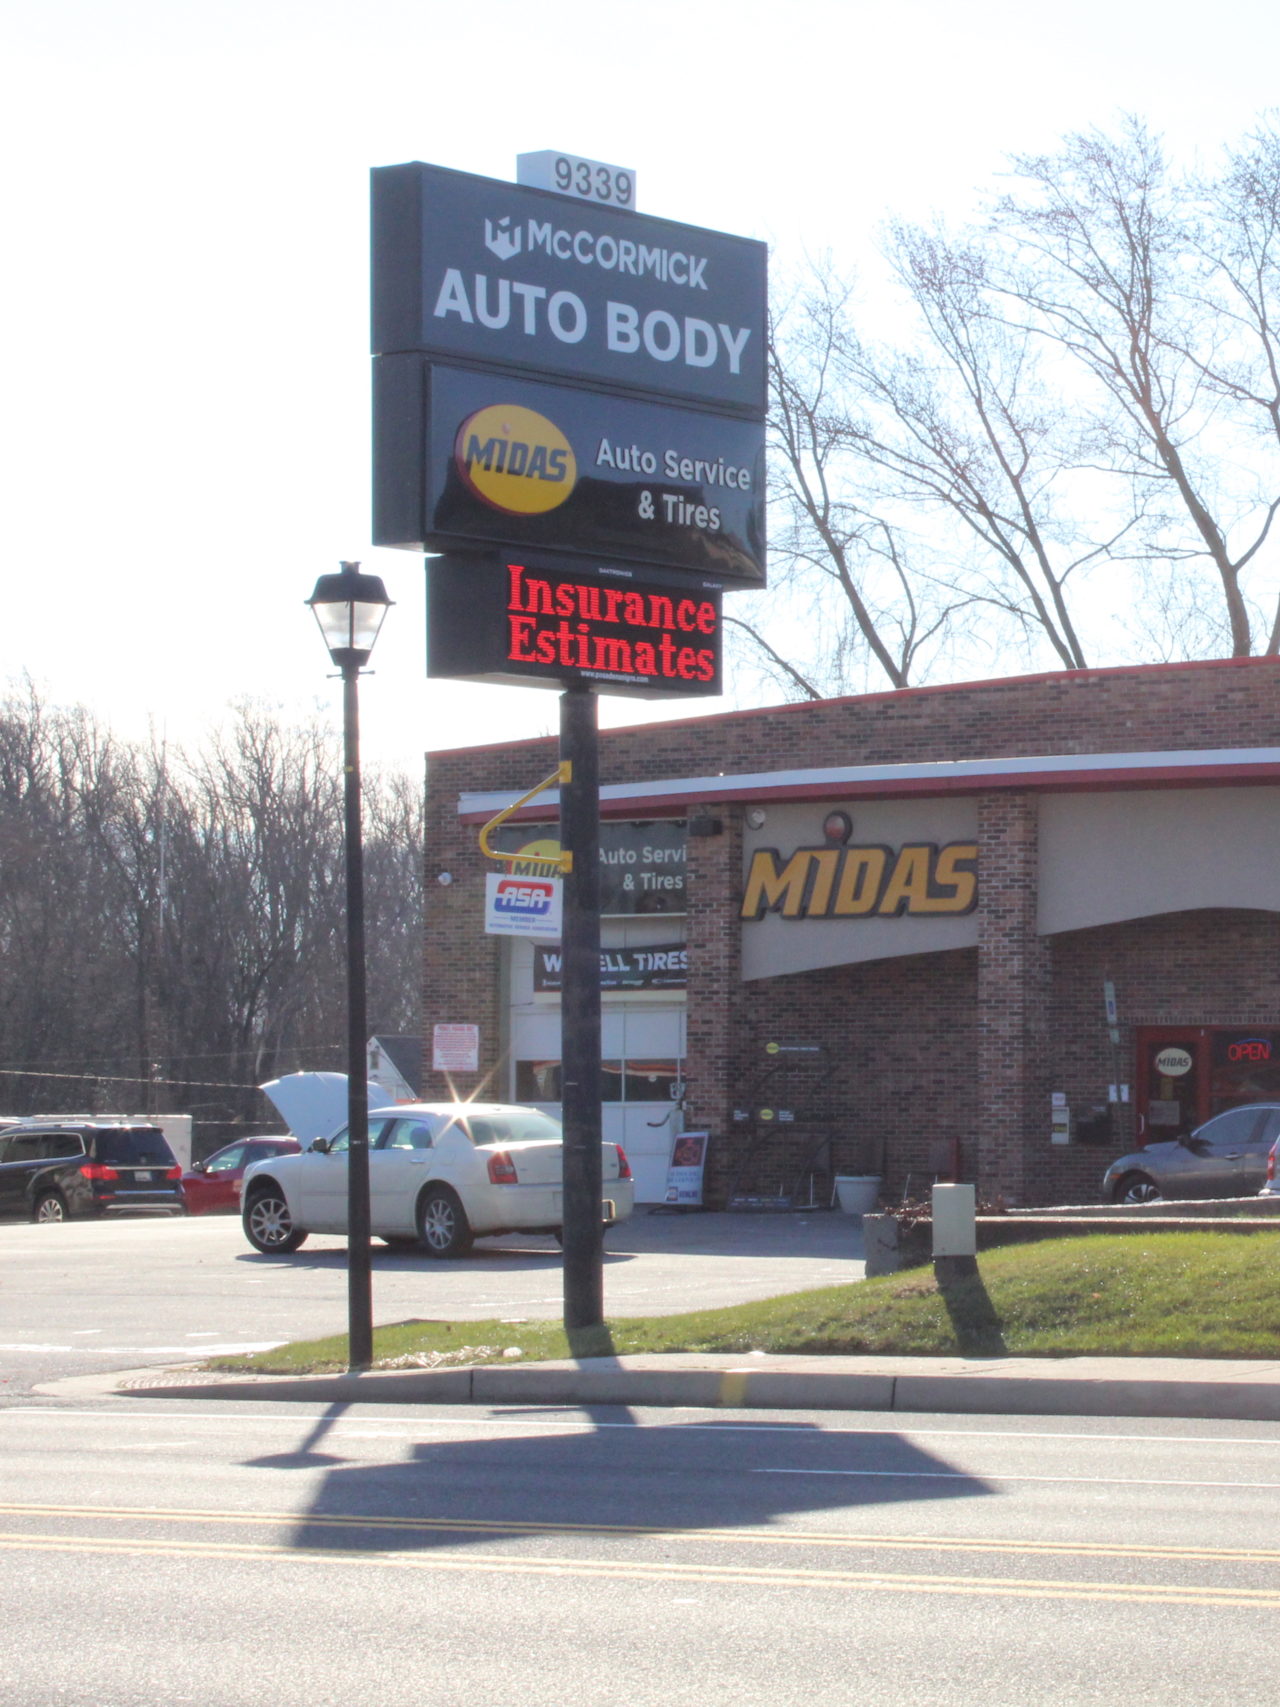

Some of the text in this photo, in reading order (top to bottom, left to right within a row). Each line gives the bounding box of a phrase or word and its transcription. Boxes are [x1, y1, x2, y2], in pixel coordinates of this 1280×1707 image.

[554, 156, 632, 206] 9339
[433, 267, 752, 375] AUTO BODY
[465, 432, 570, 483] MIDAS
[596, 437, 751, 491] Auto Service
[637, 489, 722, 531] & Tires
[506, 563, 718, 636] Insurance
[506, 614, 715, 683] Estimates
[642, 844, 687, 864] Servi
[500, 886, 547, 909] ASA
[622, 871, 684, 891] & Tires
[740, 841, 980, 921] MIDAS
[633, 950, 688, 971] TIRES
[1158, 1056, 1189, 1068] MIDAS
[1228, 1043, 1269, 1060] OPEN
